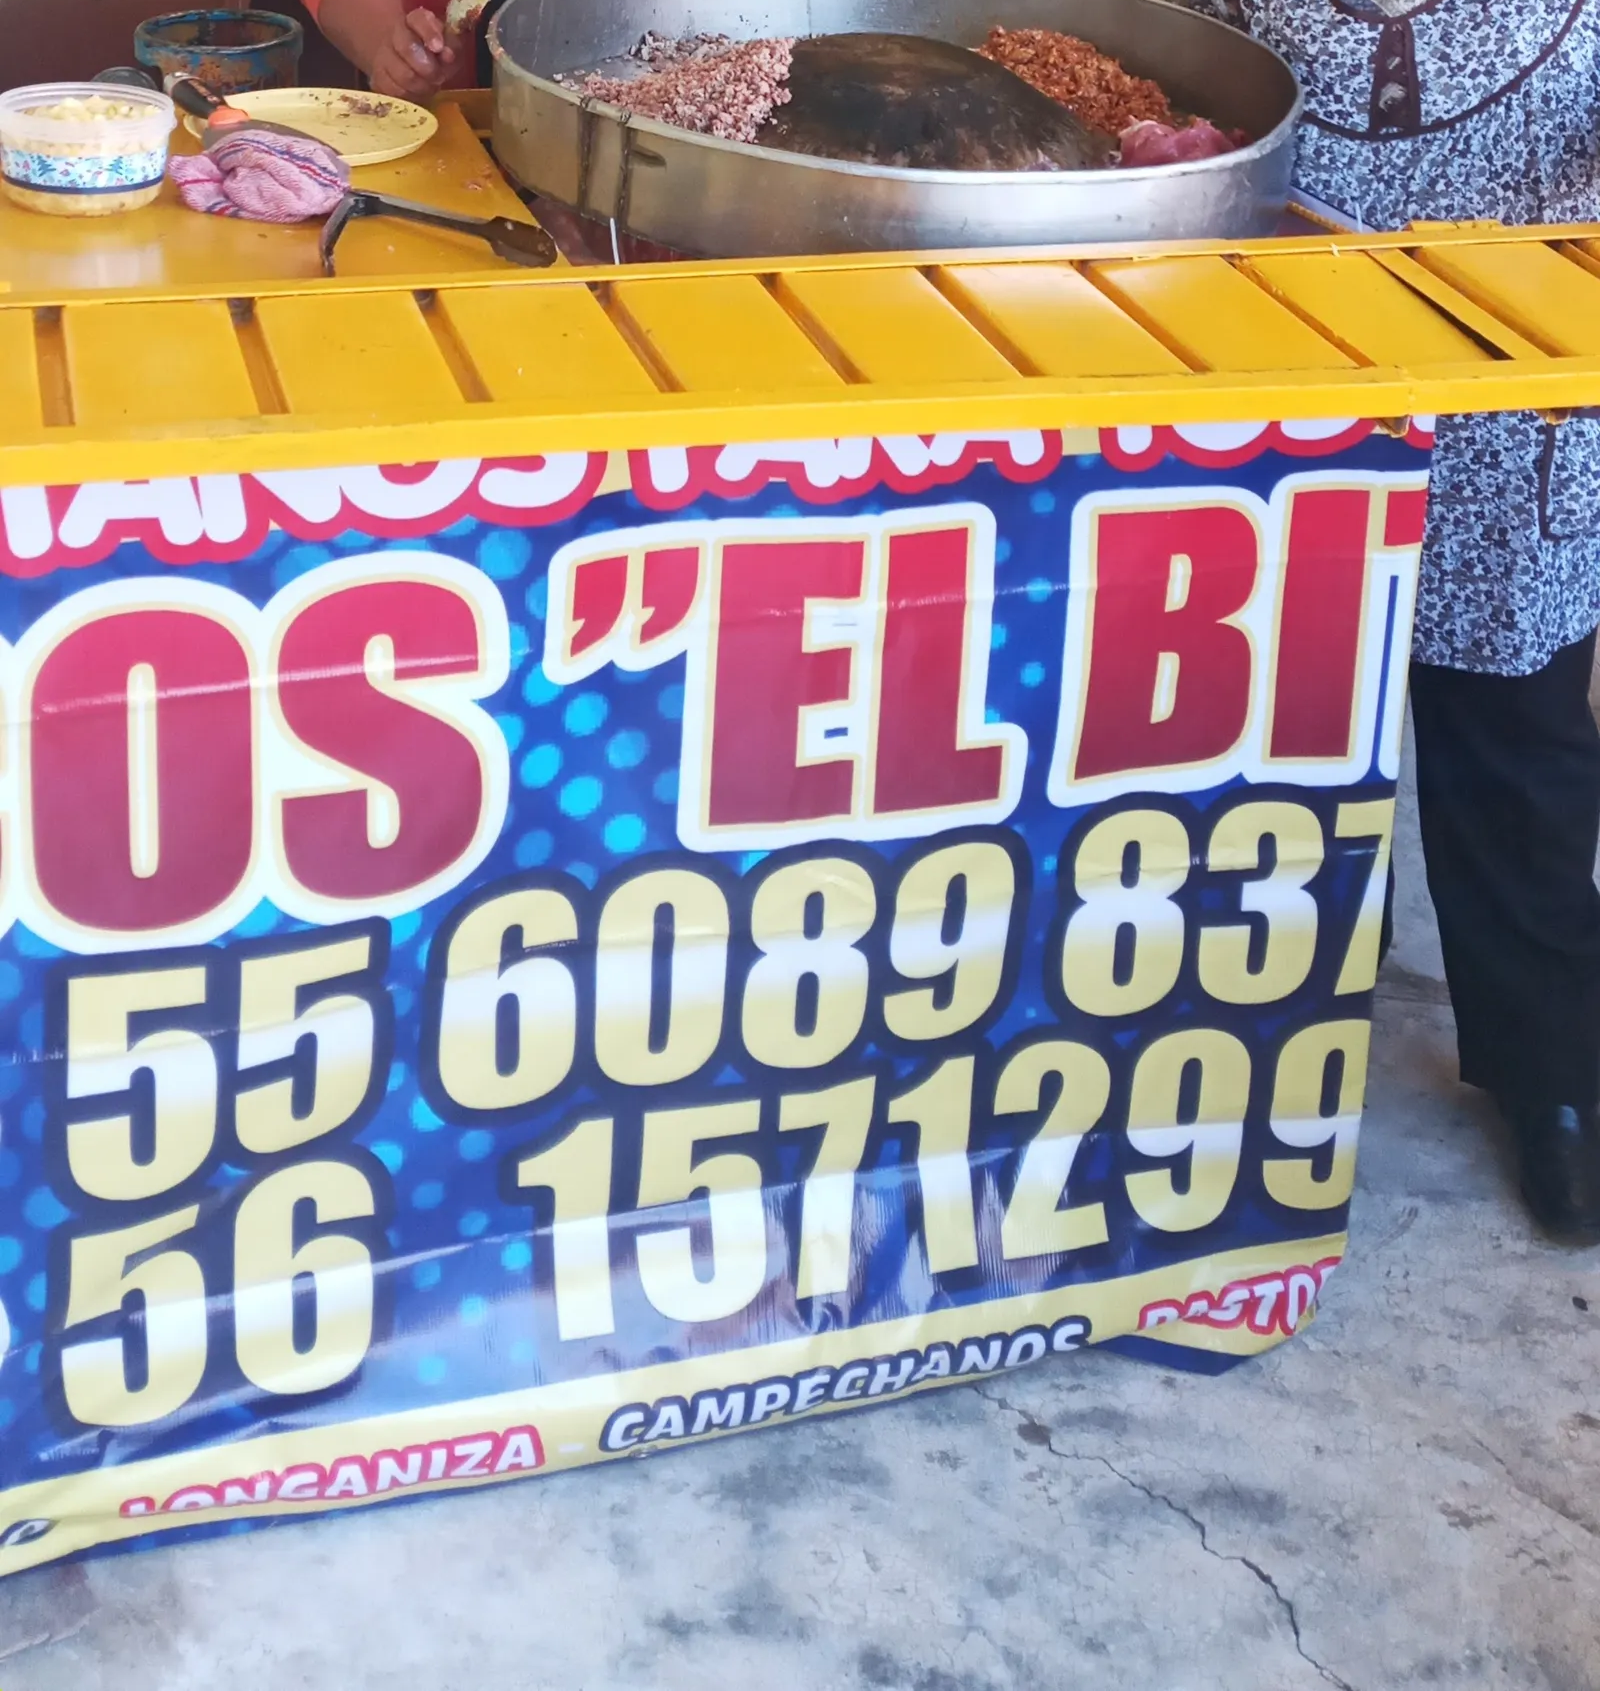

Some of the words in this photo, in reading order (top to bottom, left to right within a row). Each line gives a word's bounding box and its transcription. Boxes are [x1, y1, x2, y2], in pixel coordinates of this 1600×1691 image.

[0, 577, 486, 933] OS
[65, 935, 375, 1202] 55
[436, 839, 1017, 1111] 6089
[1060, 795, 1397, 1018] 837
[60, 1159, 376, 1427] 56
[516, 1018, 1372, 1343] 1571299
